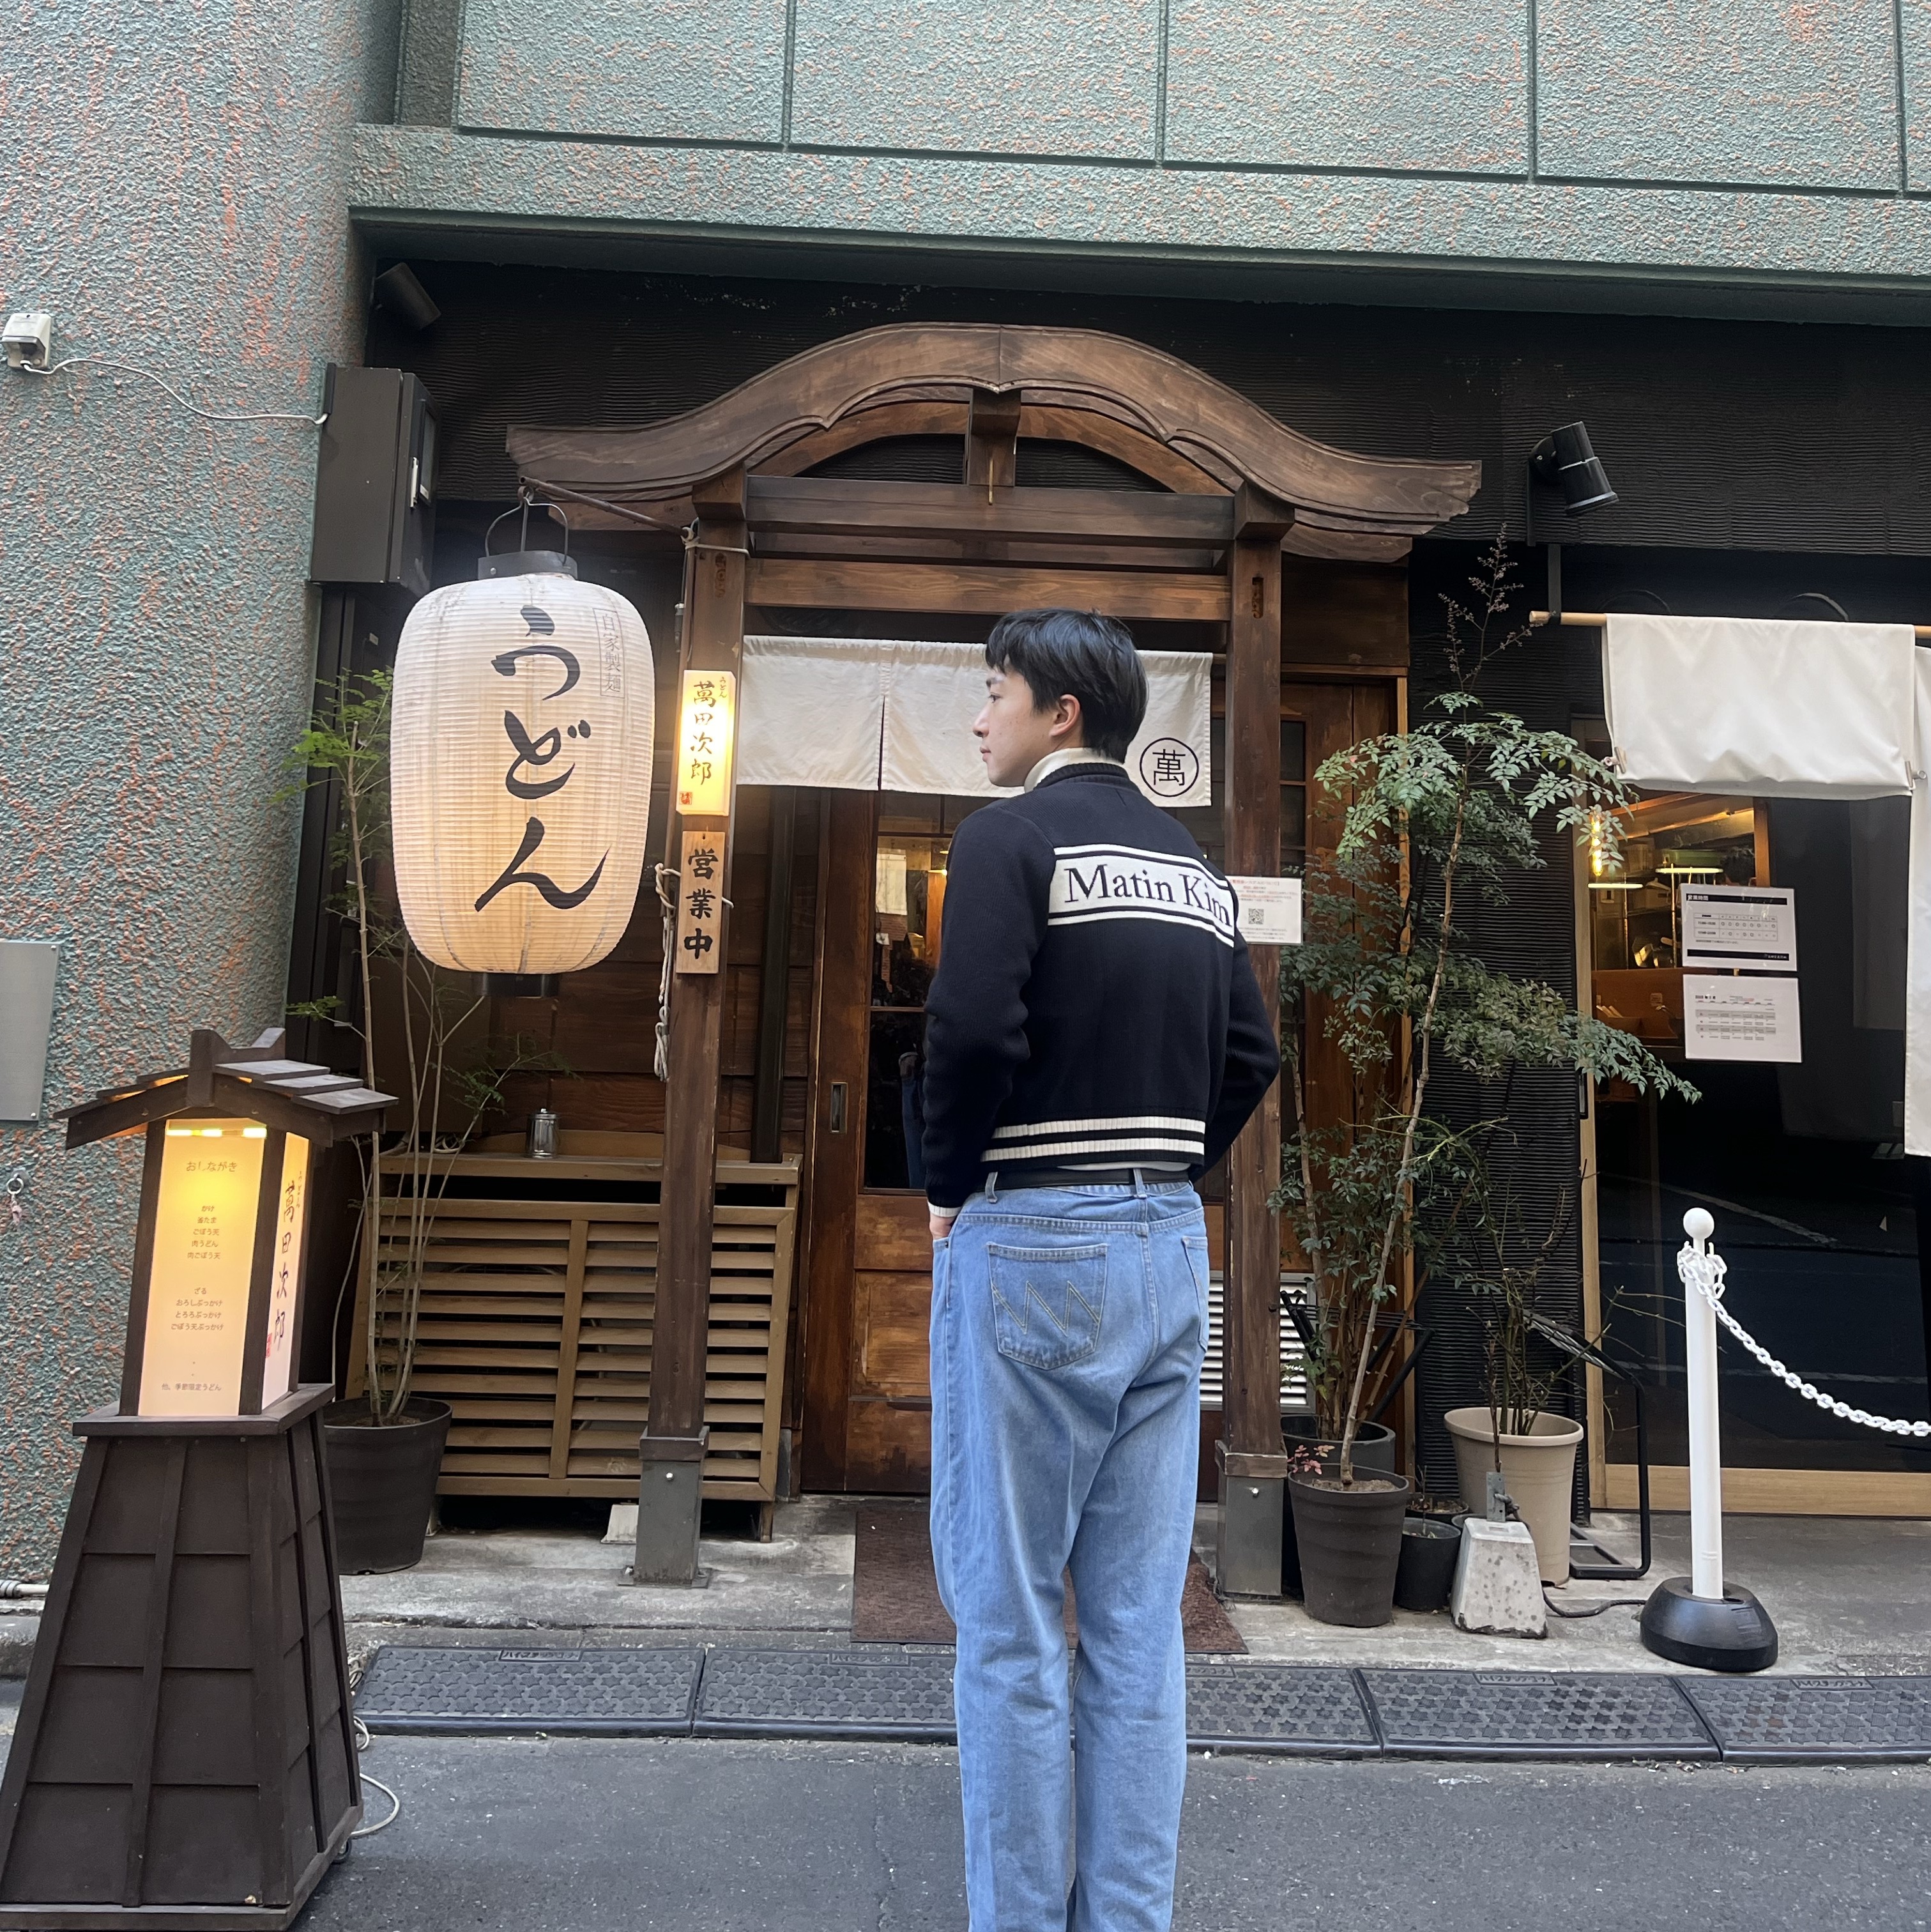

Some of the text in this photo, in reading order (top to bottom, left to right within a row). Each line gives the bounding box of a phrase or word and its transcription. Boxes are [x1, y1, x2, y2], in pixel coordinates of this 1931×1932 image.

[602, 614, 622, 693] 自家製麺
[475, 605, 612, 912] うどん
[691, 680, 717, 785] 萬田次郎
[1152, 749, 1186, 786] 萬
[683, 848, 719, 959] 営業中
[1064, 864, 1233, 926] Matin Kim
[186, 1161, 238, 1172] おしながき
[187, 1252, 221, 1260] 肉ごぼう天
[191, 1239, 218, 1248] 肉うどん
[193, 1228, 220, 1236] ごぼう天
[273, 1180, 295, 1352] 萬田次郎
